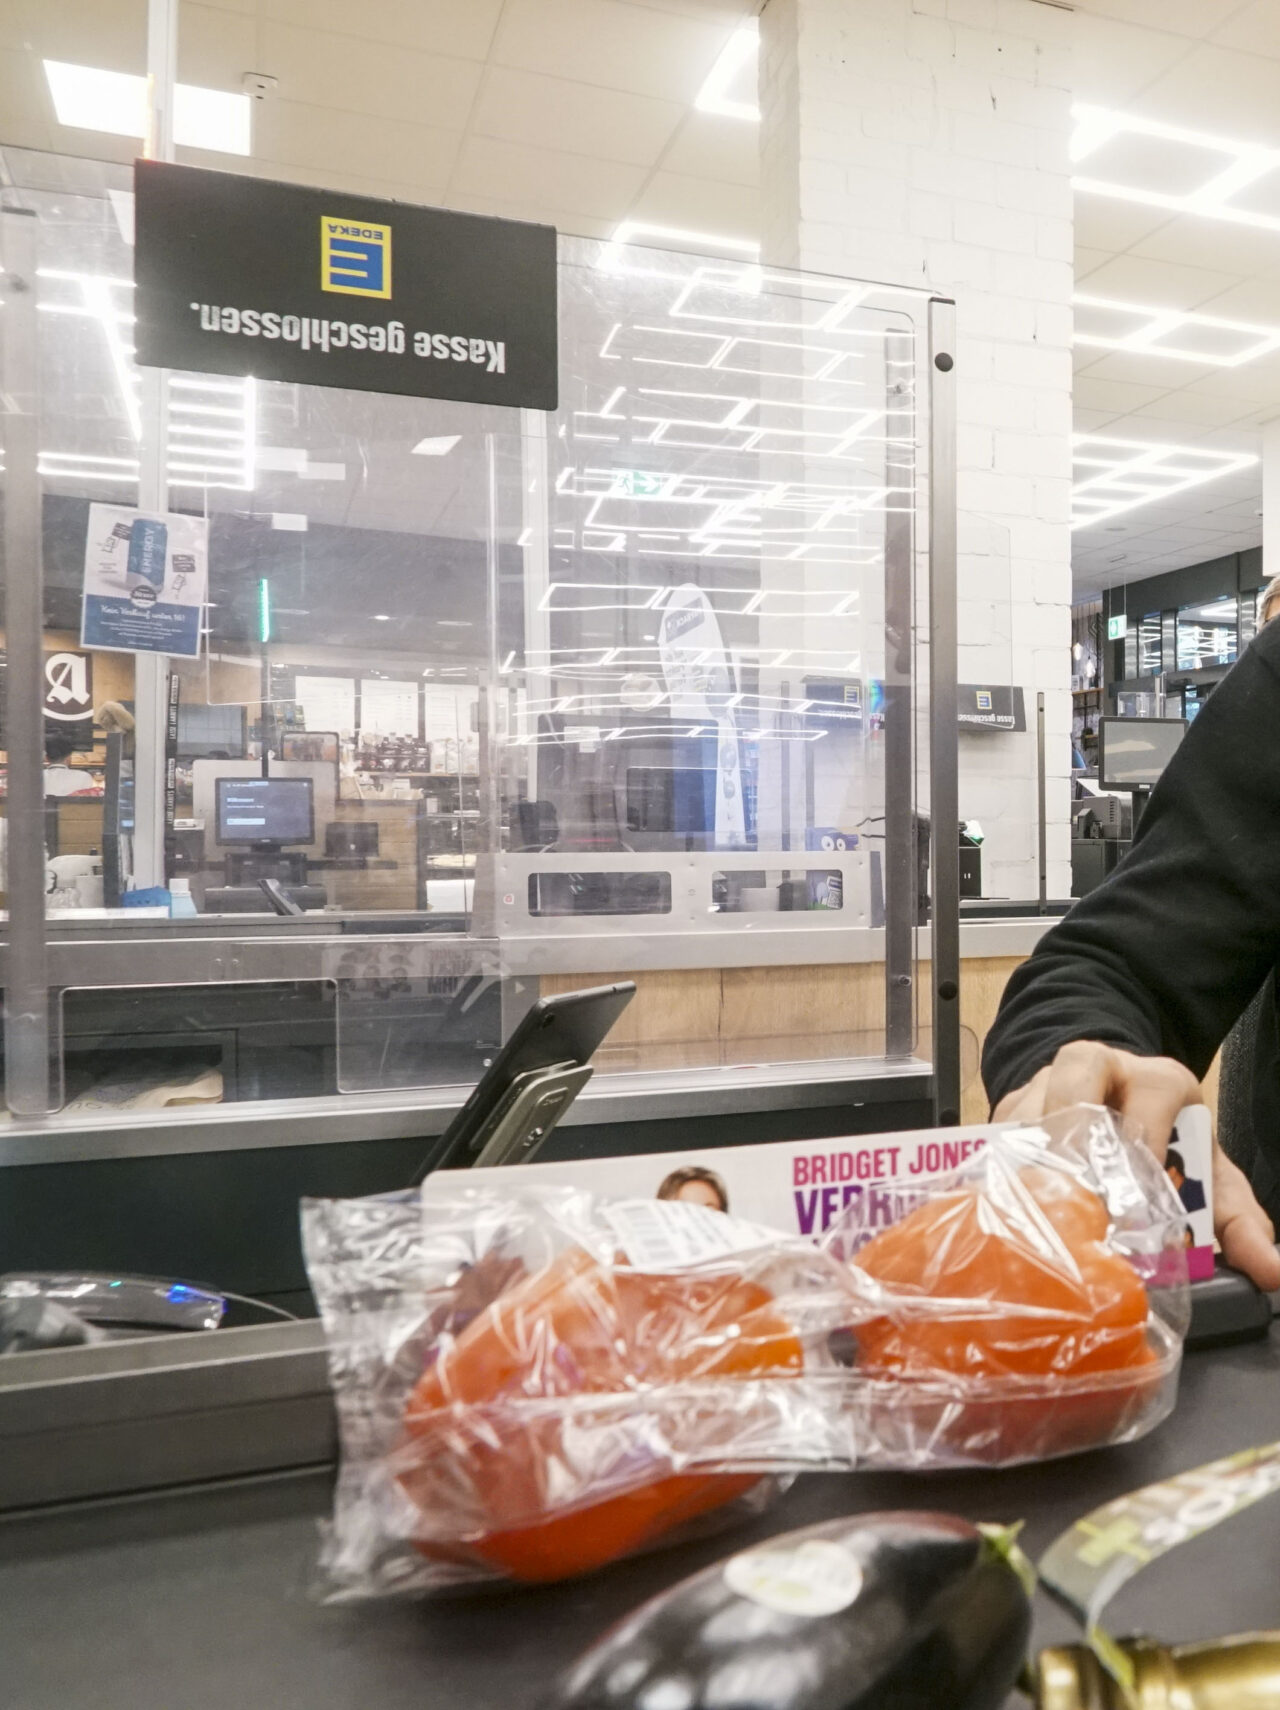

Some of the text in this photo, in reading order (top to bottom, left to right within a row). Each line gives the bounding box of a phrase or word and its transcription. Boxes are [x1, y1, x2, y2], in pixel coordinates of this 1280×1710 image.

[327, 223, 384, 240] EDEKA
[189, 302, 506, 374] Kasse geschlossen.
[793, 1147, 901, 1187] BRIDGET
